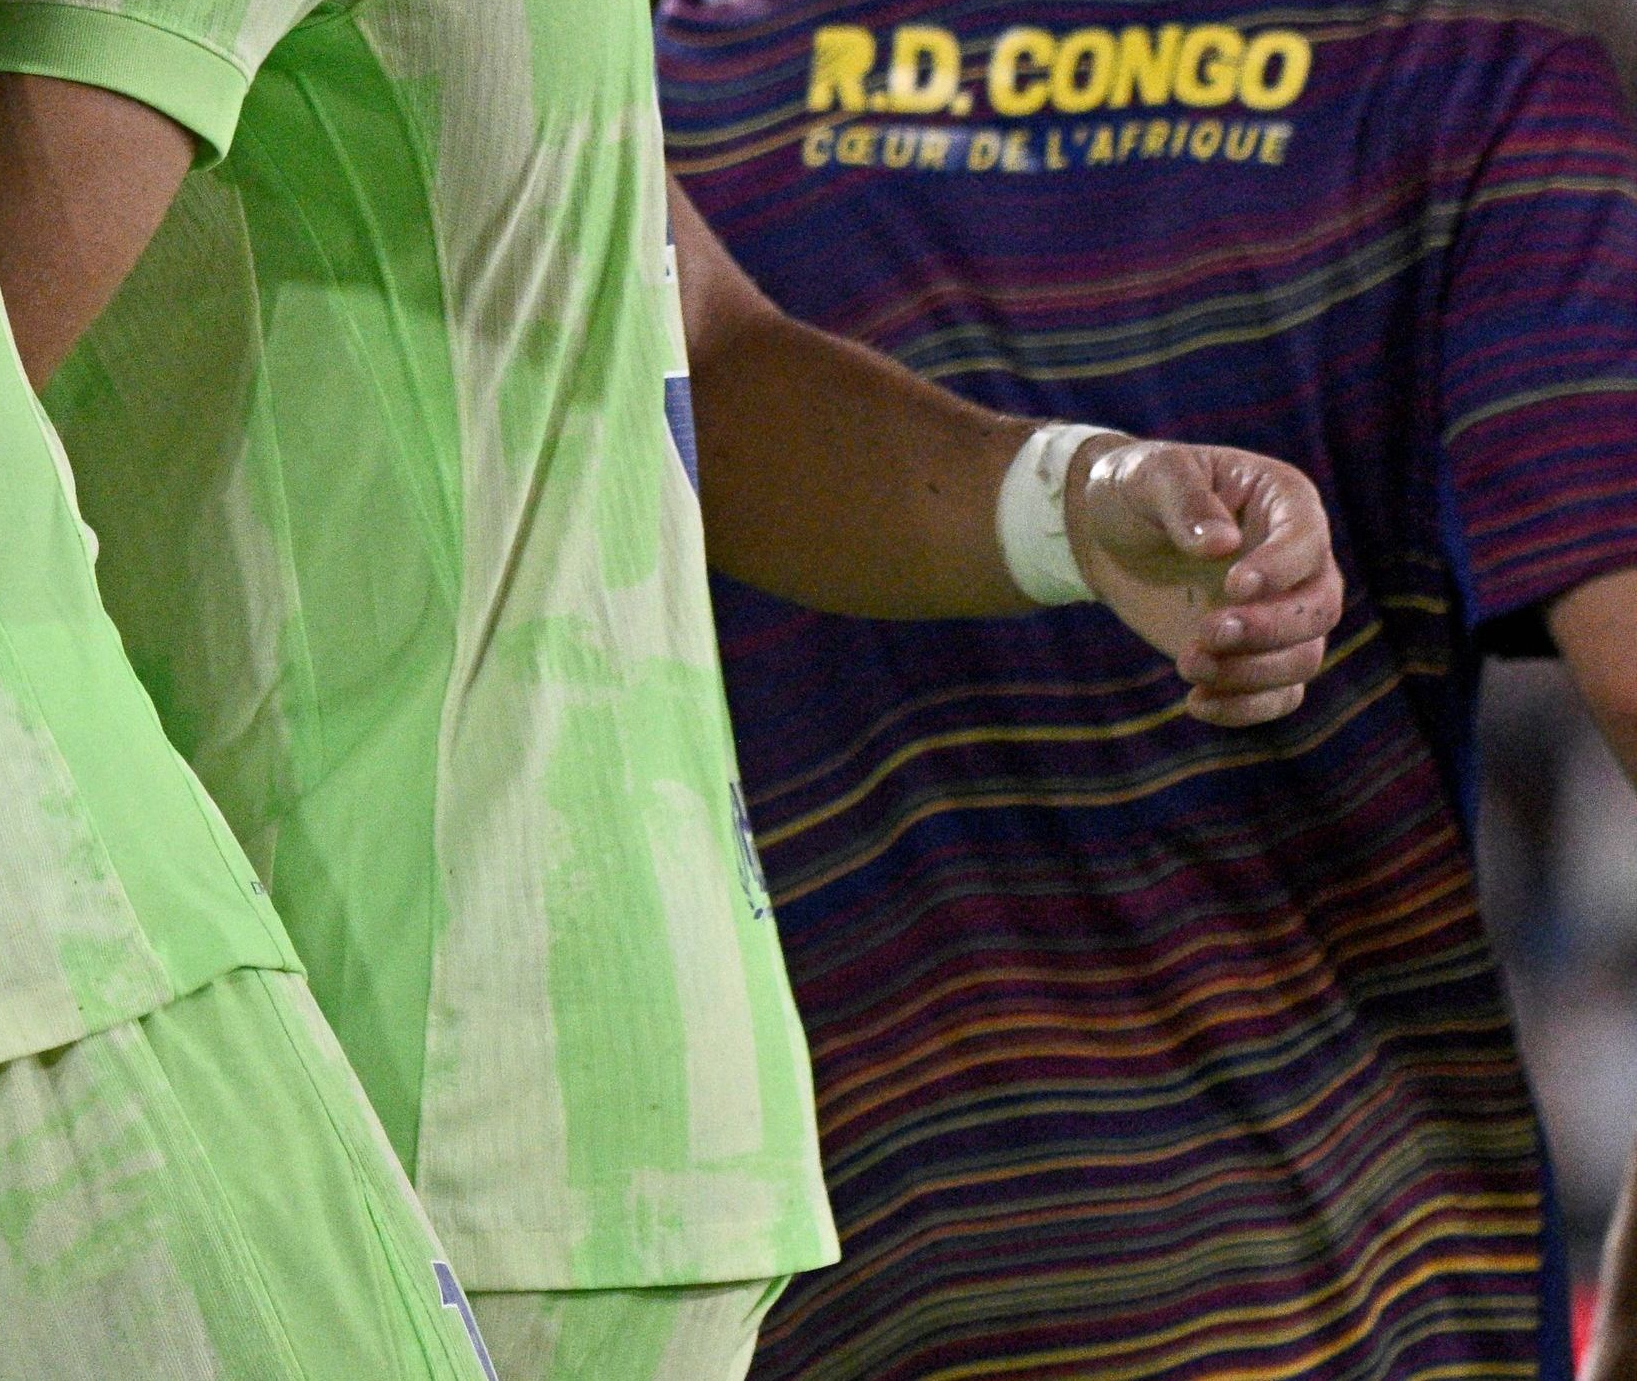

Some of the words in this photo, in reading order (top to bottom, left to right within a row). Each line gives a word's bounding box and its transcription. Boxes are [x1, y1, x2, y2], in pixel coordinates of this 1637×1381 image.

[807, 25, 972, 117] R.D.
[986, 25, 1312, 115] CONGO
[967, 129, 1030, 172] DE
